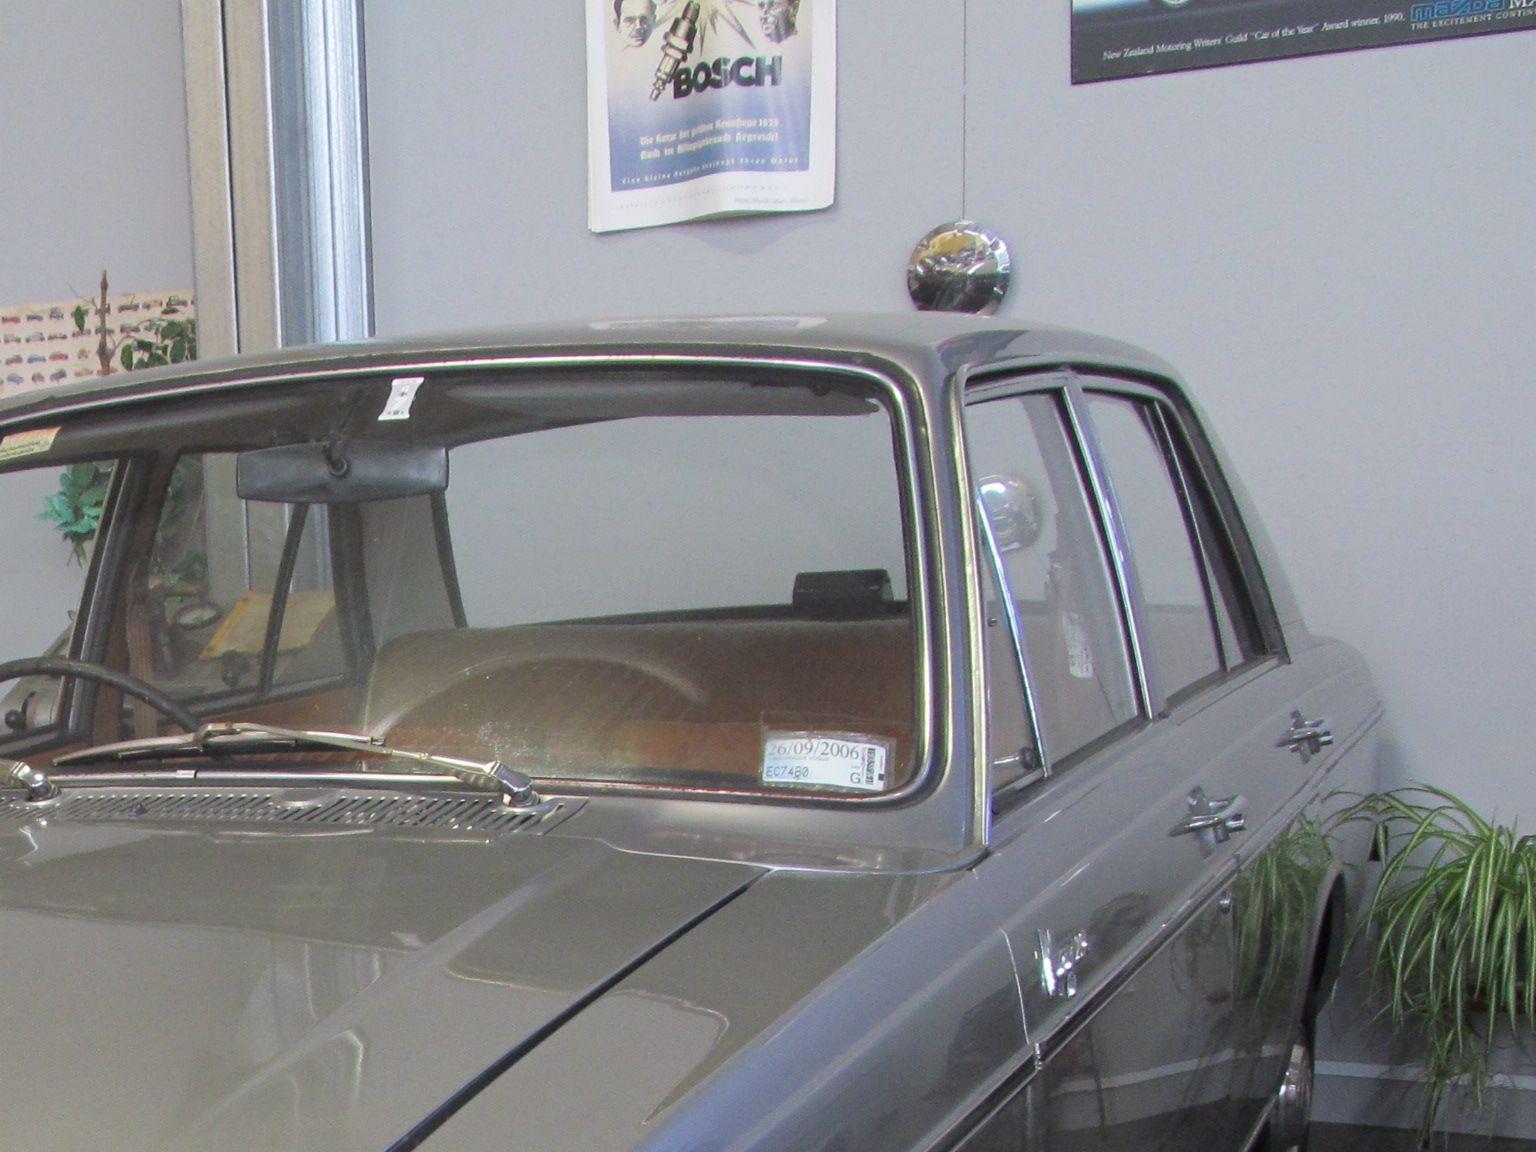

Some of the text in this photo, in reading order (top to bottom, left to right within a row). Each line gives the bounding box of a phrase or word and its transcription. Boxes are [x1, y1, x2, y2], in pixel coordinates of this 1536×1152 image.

[1411, 22, 1430, 31] THE
[1431, 13, 1493, 28] EXCITEMENT
[1103, 50, 1122, 60] New
[1123, 45, 1154, 57] Zealand
[1155, 41, 1193, 53] Motoring
[1225, 33, 1248, 44] Guild
[1271, 29, 1281, 37] of
[1281, 27, 1296, 36] the
[1321, 19, 1349, 31] Award
[673, 55, 783, 99] BOSCH
[767, 740, 860, 760] 26/09/2006
[849, 772, 861, 784] G
